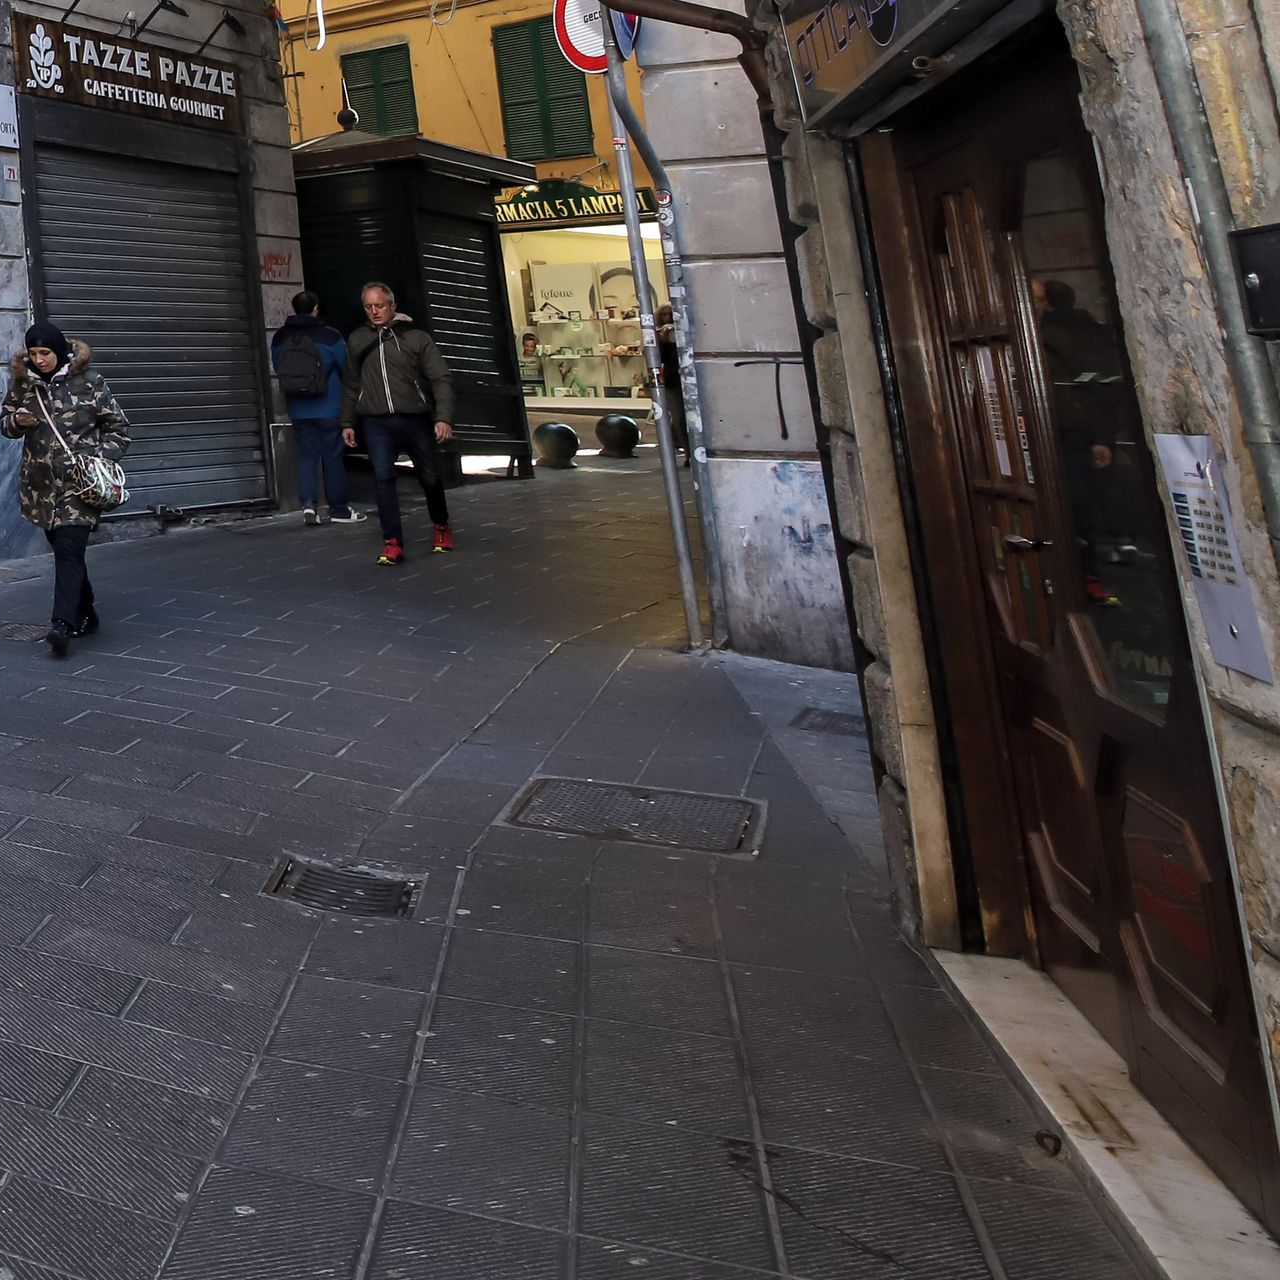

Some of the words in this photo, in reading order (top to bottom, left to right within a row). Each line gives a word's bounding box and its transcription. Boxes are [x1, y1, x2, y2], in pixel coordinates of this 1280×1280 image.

[63, 33, 152, 79] TAZZE
[158, 56, 237, 98] PAZZE
[26, 78, 37, 88] 20
[83, 79, 167, 110] CAFFETTERIA
[170, 96, 225, 120] GOURMET
[7, 167, 16, 179] 71
[495, 201, 555, 223] RMACIA
[555, 200, 568, 218] 5
[568, 193, 650, 217] LAMPAI
